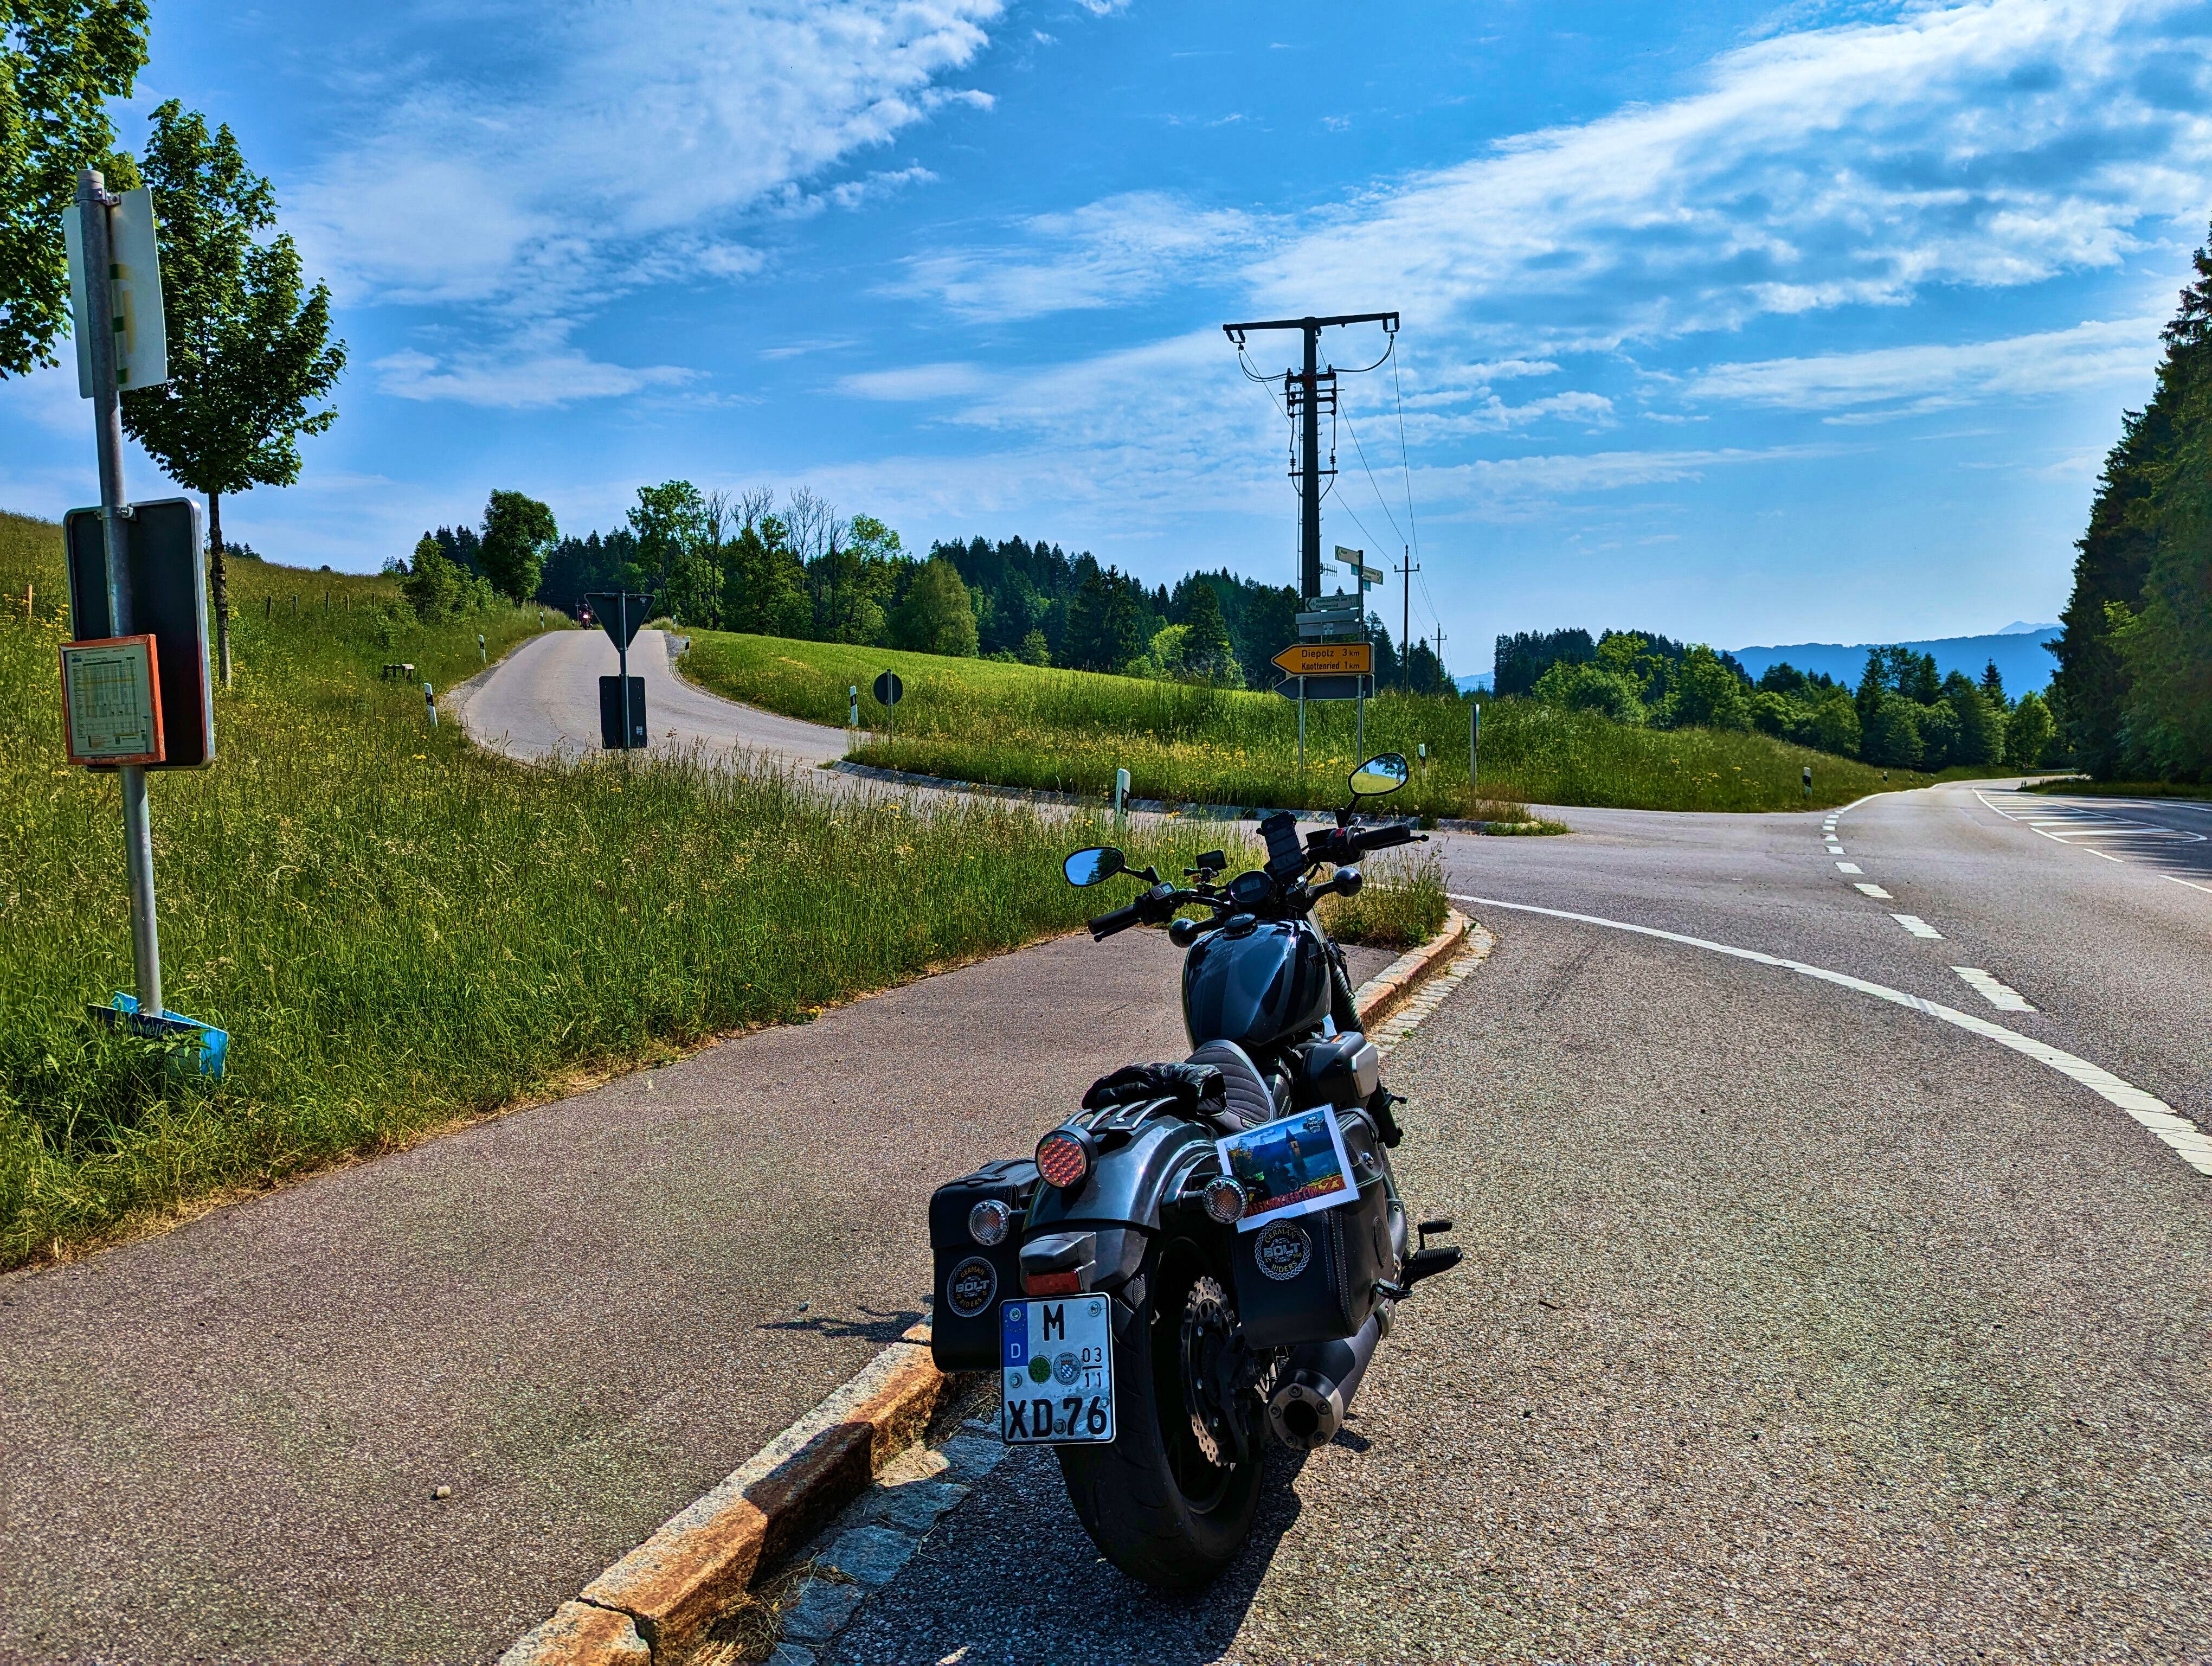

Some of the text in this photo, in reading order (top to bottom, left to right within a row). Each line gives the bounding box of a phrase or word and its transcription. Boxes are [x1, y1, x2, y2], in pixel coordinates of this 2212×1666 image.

[1302, 649, 1334, 659] Diepolz
[1342, 648, 1347, 657] 3
[1302, 661, 1340, 670] Knottenried
[1344, 661, 1347, 669] 1
[1244, 1176, 1345, 1218] ASSKNACKER.COM 23
[1265, 1228, 1296, 1243] GERMAN
[1263, 1242, 1301, 1258] BOLT
[960, 1266, 986, 1278] GERMAN
[1271, 1260, 1297, 1272] RIDERS
[955, 1280, 990, 1293] BOLT
[959, 1298, 982, 1307] RIDERS
[1043, 1304, 1065, 1341] M
[1011, 1343, 1021, 1359] D
[1082, 1347, 1102, 1363] 03
[1084, 1372, 1101, 1388] 11
